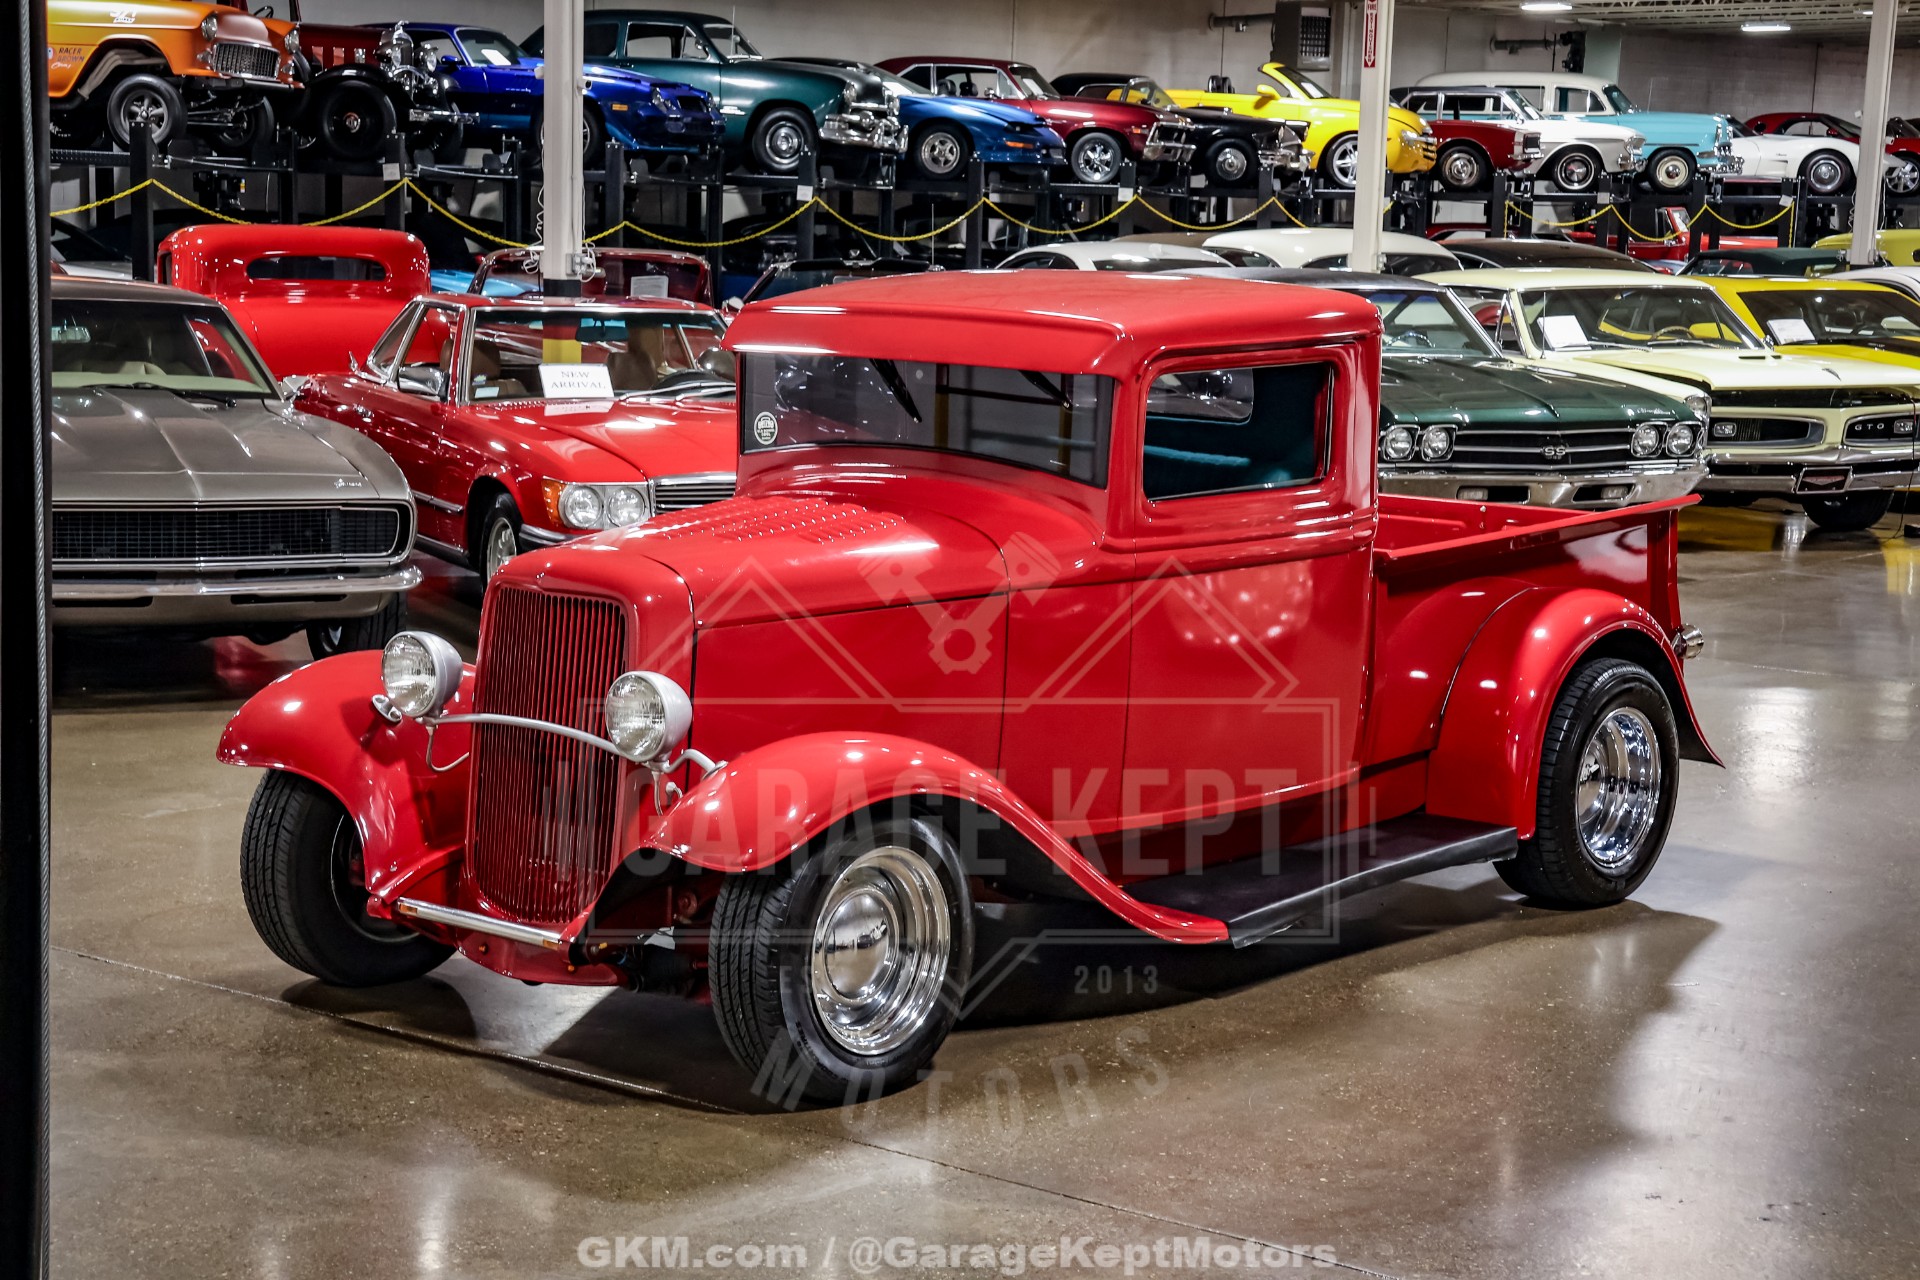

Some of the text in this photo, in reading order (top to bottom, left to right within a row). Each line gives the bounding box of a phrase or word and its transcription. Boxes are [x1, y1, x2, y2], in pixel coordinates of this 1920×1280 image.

[58, 47, 82, 55] RACER
[561, 371, 589, 379] NEW
[551, 381, 606, 390] ARRIVAL
[1854, 422, 1885, 431] GTO
[1544, 446, 1566, 456] SS
